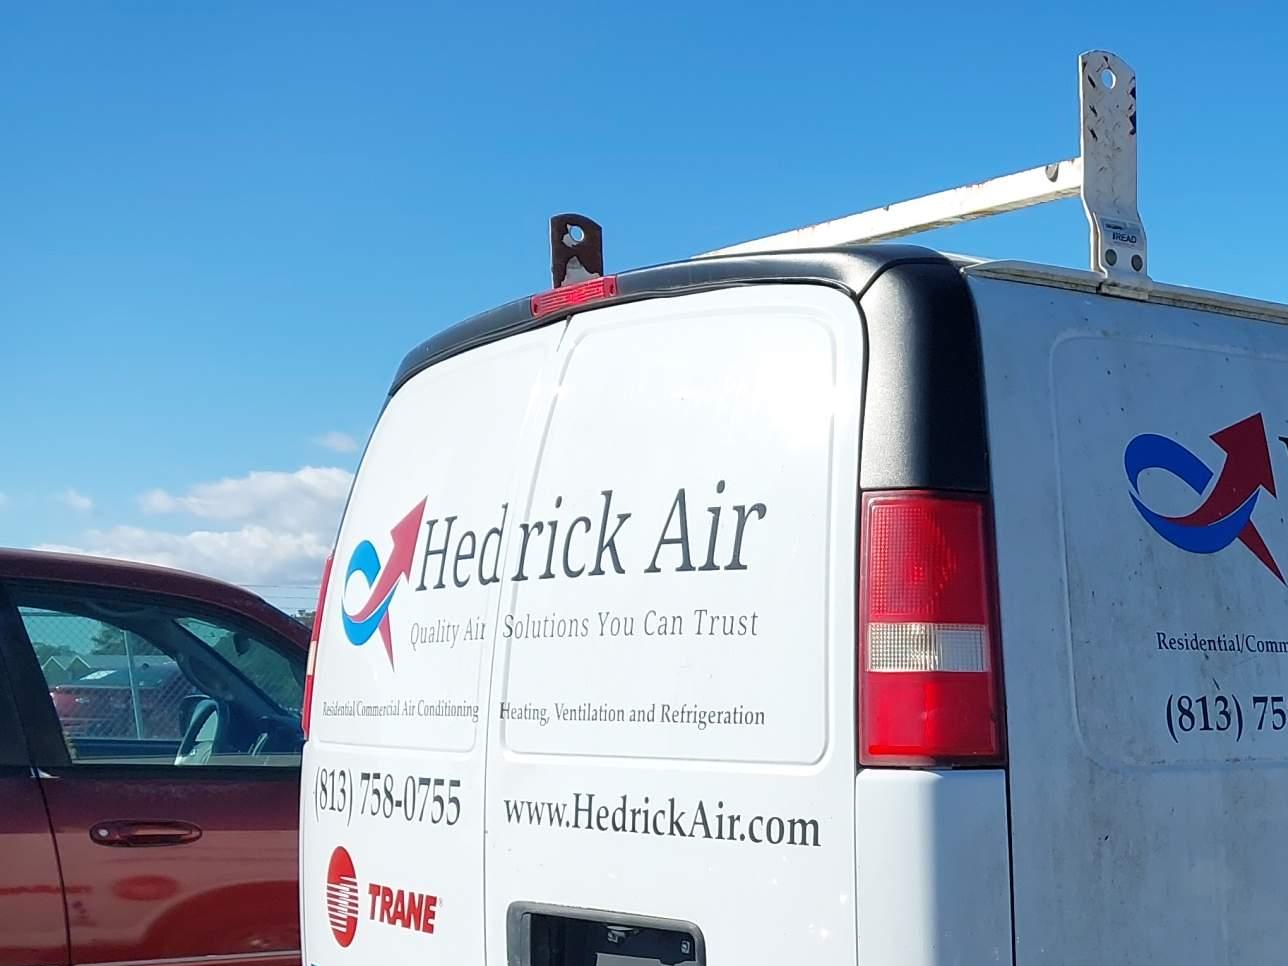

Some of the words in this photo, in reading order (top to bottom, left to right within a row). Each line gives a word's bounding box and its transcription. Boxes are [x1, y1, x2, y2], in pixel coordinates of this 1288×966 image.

[415, 489, 632, 593] Hedrick
[644, 479, 767, 574] Air
[410, 615, 458, 652] Quality
[463, 617, 486, 643] Air
[502, 612, 590, 640] Solutions
[597, 610, 634, 638] You
[643, 609, 683, 637] Can
[694, 608, 759, 637] Trust
[402, 700, 416, 717] Air
[417, 699, 479, 723] Conditioning
[499, 702, 551, 726] Heating,
[555, 703, 625, 723] Ventilation
[629, 704, 656, 724] and
[660, 703, 766, 730] Refrigeration
[1165, 694, 1243, 743] (813)
[314, 766, 353, 828] (813)
[360, 773, 462, 827] 758-0755
[504, 792, 822, 848] www.HedrickAir.com
[368, 883, 437, 935] TRANE
